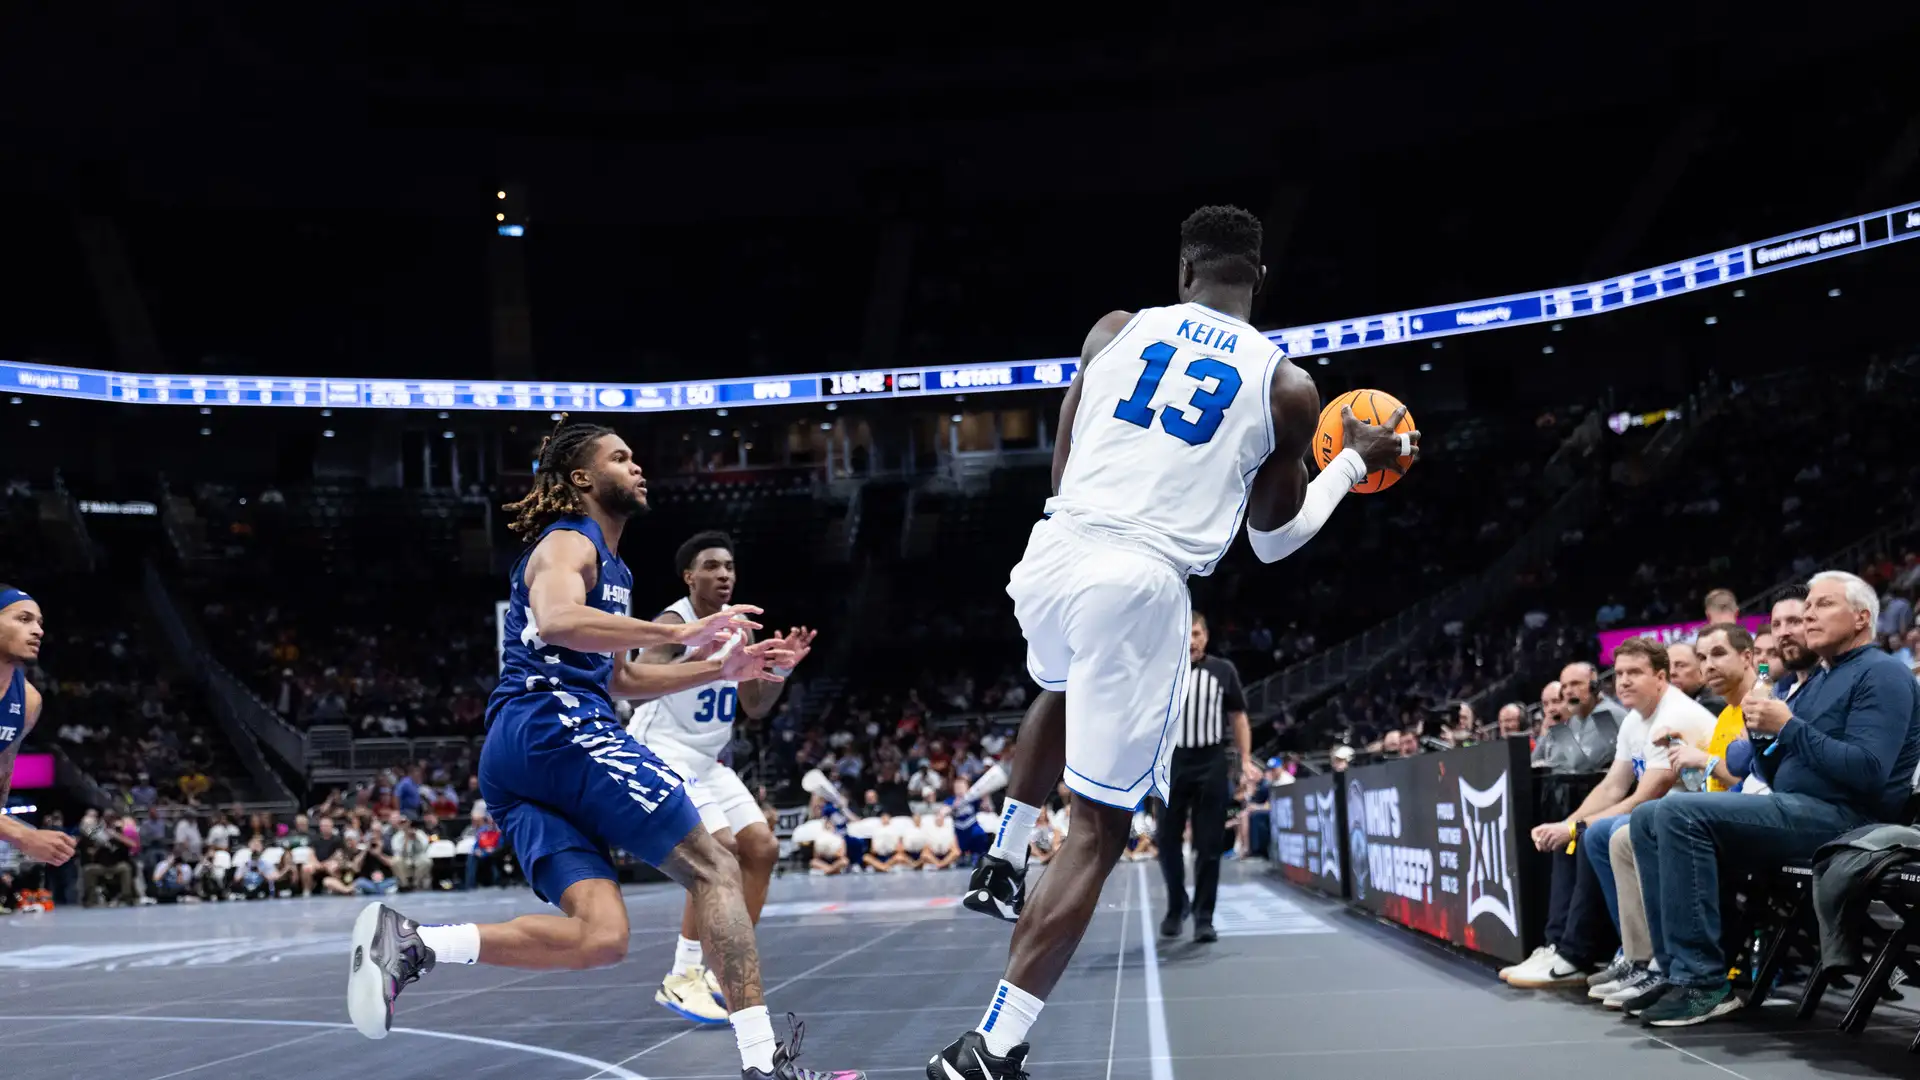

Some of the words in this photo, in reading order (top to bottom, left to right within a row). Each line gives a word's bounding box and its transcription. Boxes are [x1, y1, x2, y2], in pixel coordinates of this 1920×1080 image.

[1757, 237, 1819, 264] Grambling
[1818, 228, 1856, 249] State
[1176, 319, 1239, 353] KEITA
[940, 368, 1012, 387] K-STATE
[1113, 341, 1242, 446] 13
[694, 686, 737, 722] 30
[1392, 846, 1433, 904] BEEF?
